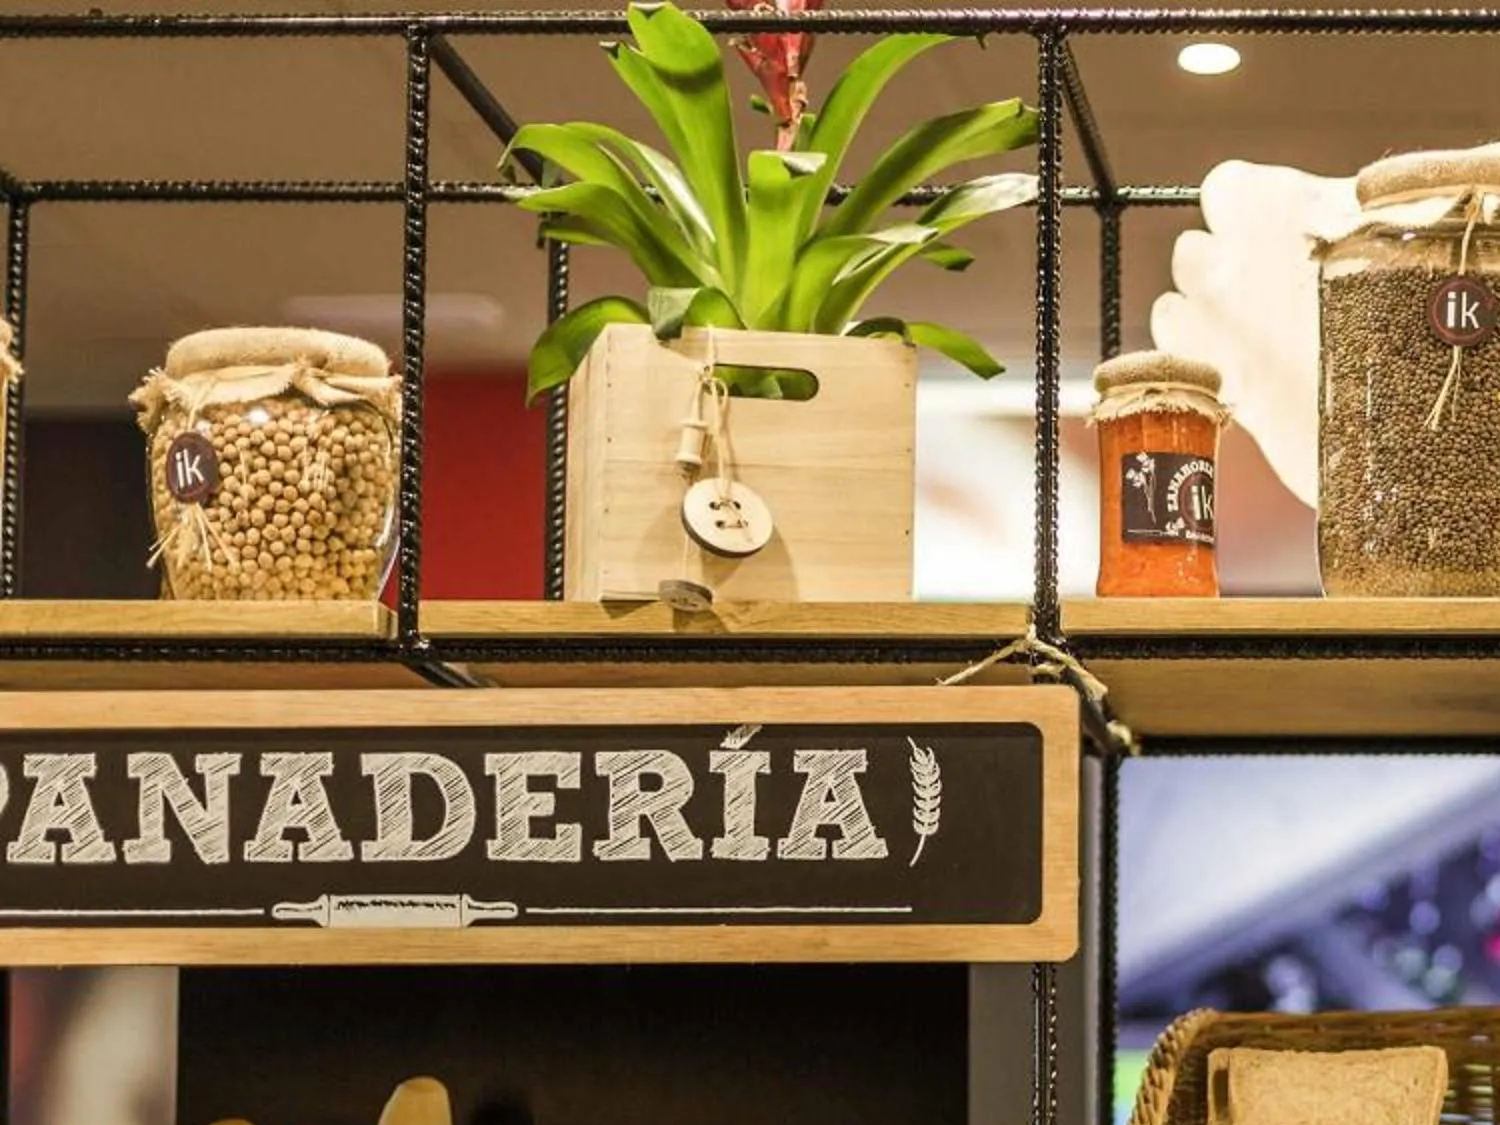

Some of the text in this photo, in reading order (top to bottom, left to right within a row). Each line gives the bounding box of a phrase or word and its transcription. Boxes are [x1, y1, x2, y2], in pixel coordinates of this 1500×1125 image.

[1447, 291, 1479, 328] ik
[175, 448, 205, 489] ik
[1191, 485, 1214, 520] ik
[0, 725, 890, 866] ANADERÍA
